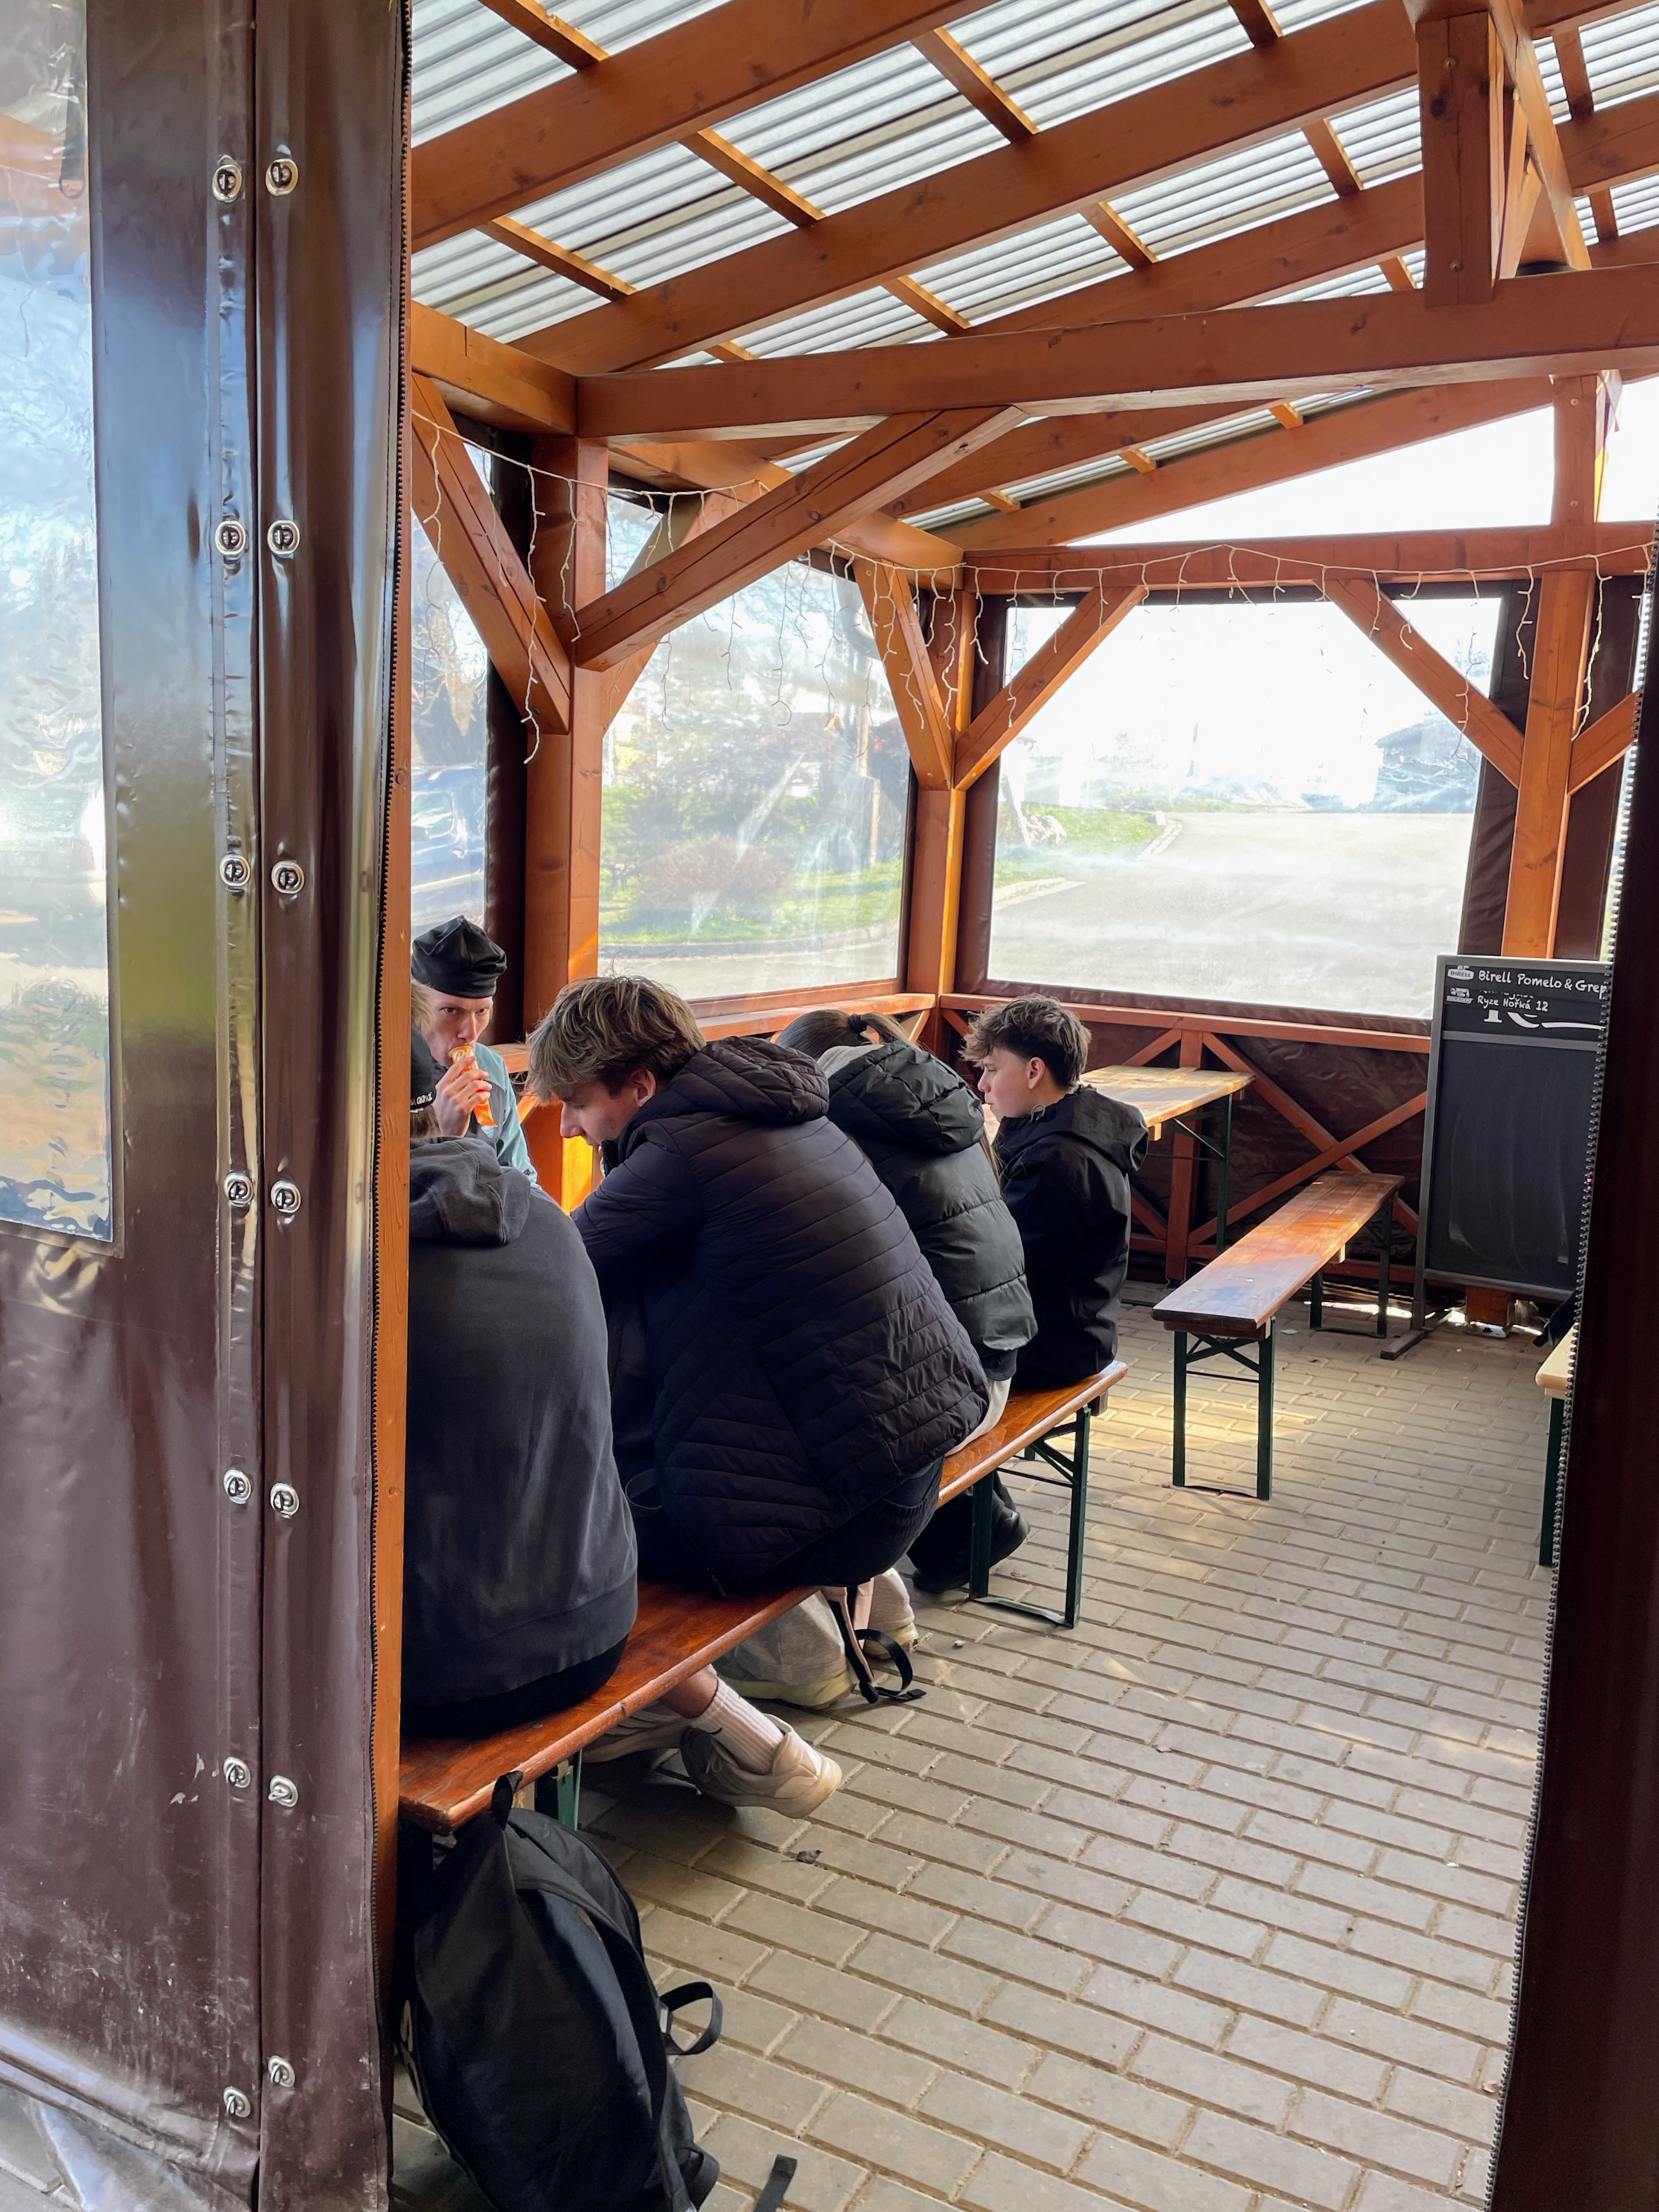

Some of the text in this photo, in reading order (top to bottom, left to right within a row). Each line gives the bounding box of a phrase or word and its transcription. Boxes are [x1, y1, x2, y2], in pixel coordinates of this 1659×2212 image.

[1478, 970, 1512, 984] Birell
[1517, 973, 1563, 988] Pomelo
[1564, 978, 1573, 991] &
[1477, 995, 1499, 1009] Ryze
[1503, 998, 1531, 1010] Hořká
[1536, 1000, 1549, 1012] 12
